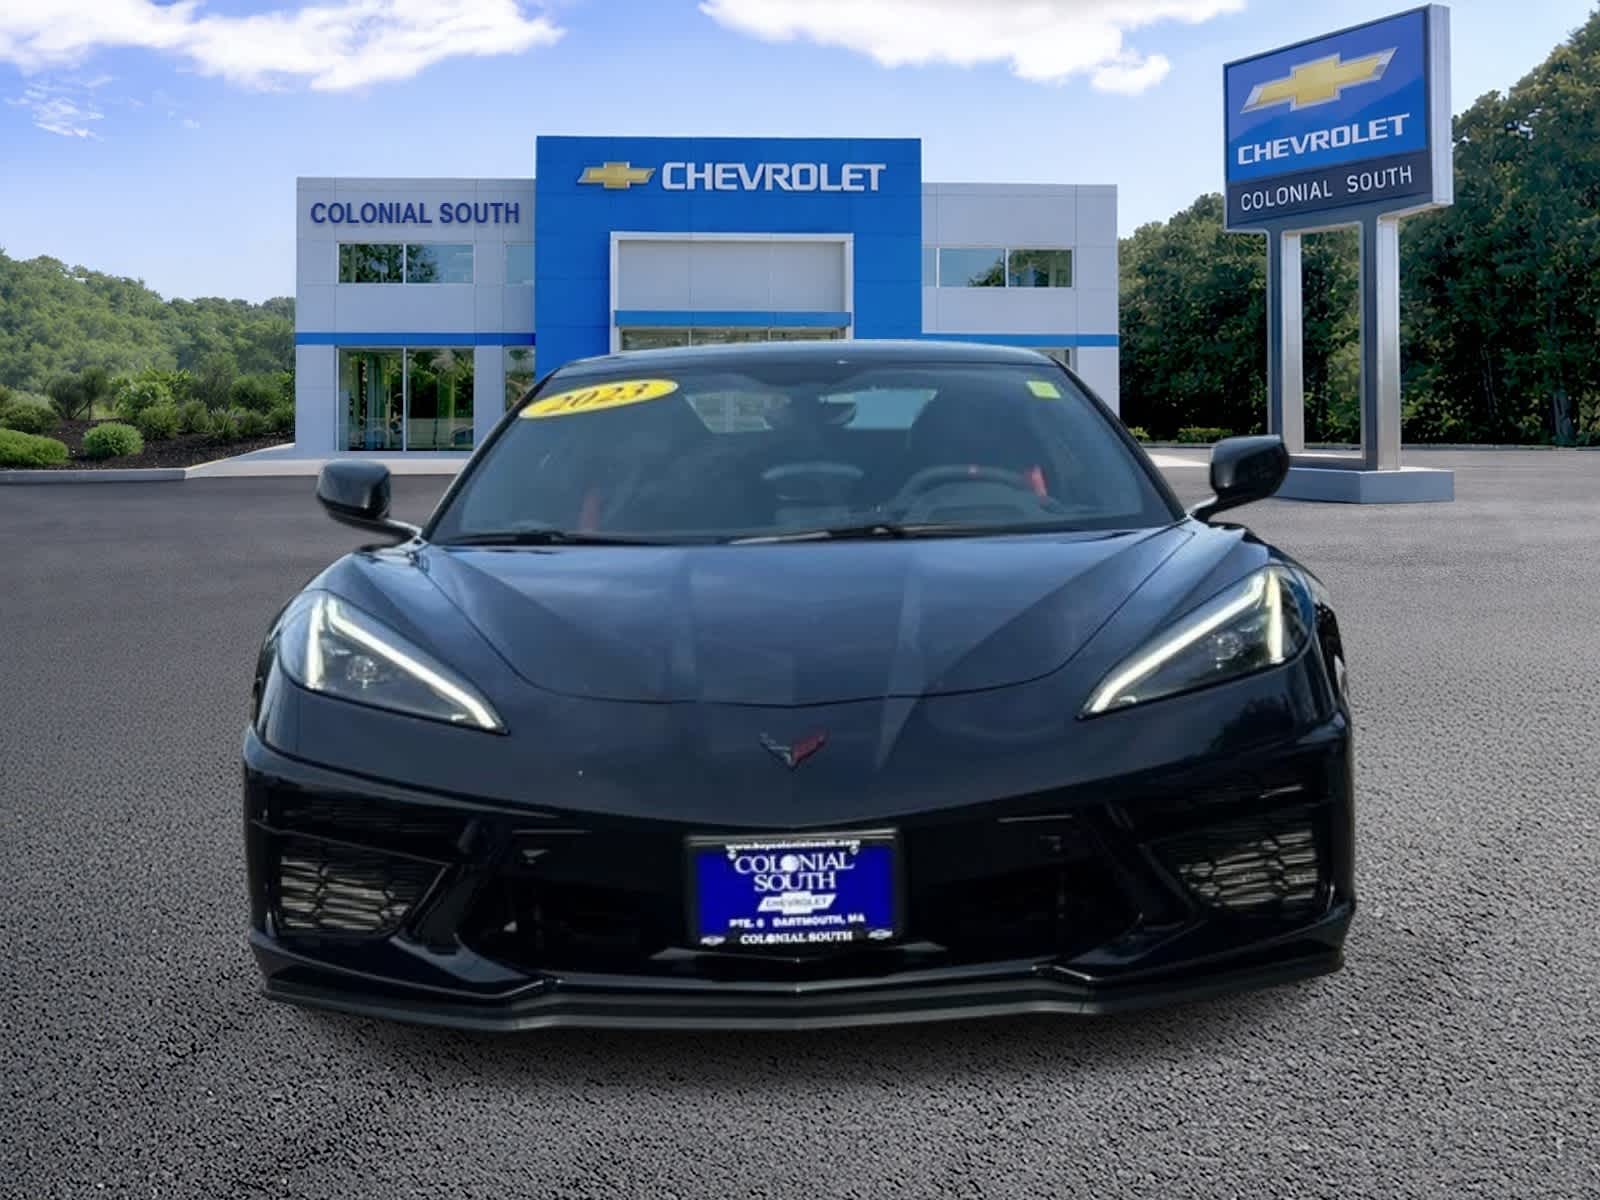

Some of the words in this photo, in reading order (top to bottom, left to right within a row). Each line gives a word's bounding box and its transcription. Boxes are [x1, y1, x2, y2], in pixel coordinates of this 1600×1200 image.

[1237, 112, 1410, 165] CHEVROLET
[661, 161, 887, 193] CHEVROLET
[1240, 180, 1333, 211] COLONIAL
[1346, 165, 1413, 193] SOUTH
[310, 202, 432, 225] COLONIAL
[438, 201, 521, 224] SOUTH
[735, 852, 855, 873] COLONIAL
[754, 872, 836, 891] SOUTH
[847, 913, 866, 923] MA
[740, 933, 805, 945] COLONIAL
[808, 931, 853, 943] SOUTH
